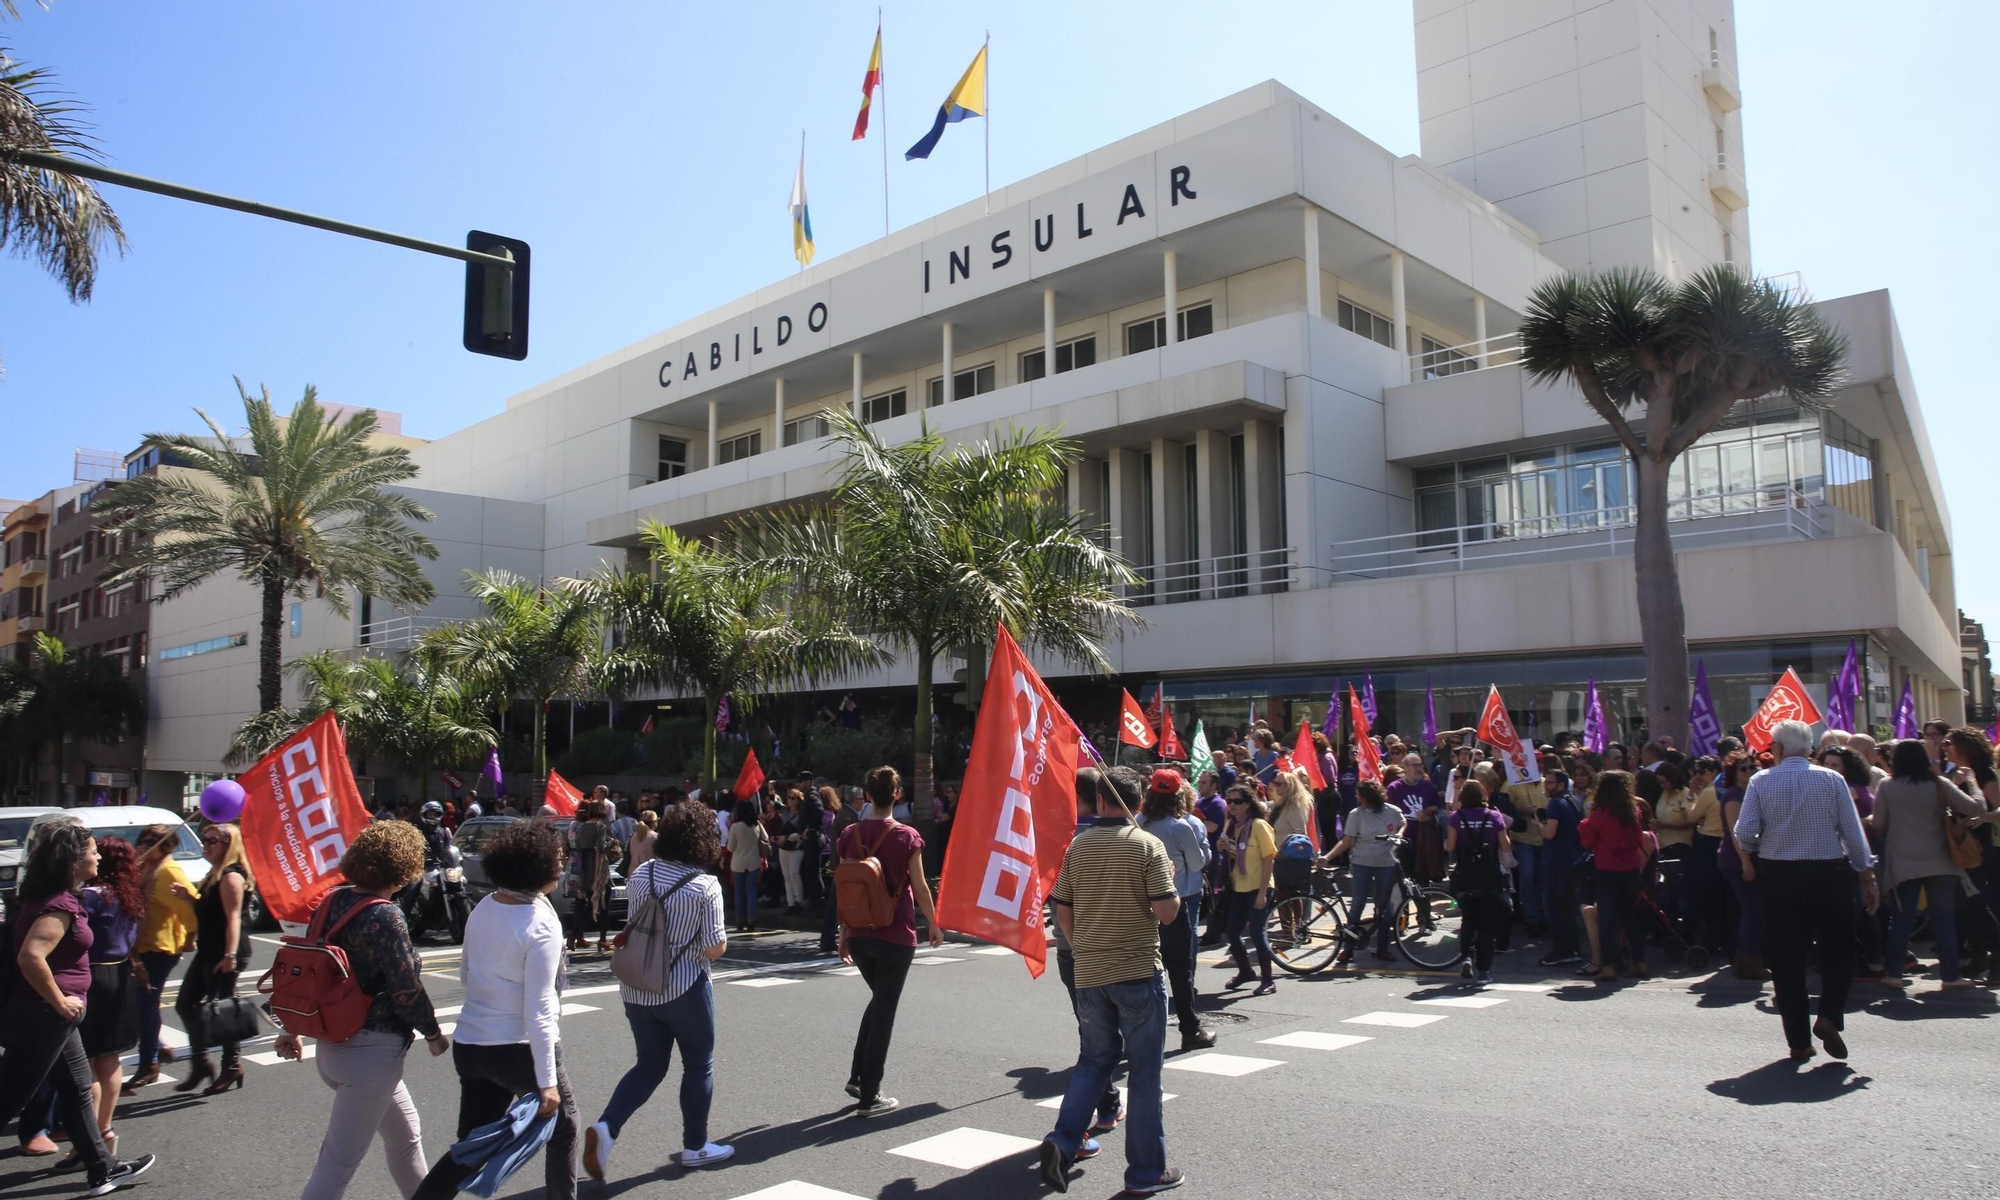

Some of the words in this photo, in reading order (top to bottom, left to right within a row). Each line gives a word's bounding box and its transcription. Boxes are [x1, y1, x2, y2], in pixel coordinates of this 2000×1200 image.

[659, 302, 828, 388] CABILDO
[924, 165, 1197, 293] INSULAR
[278, 802, 287, 811] a
[281, 810, 290, 821] la
[282, 736, 347, 876] CCOO
